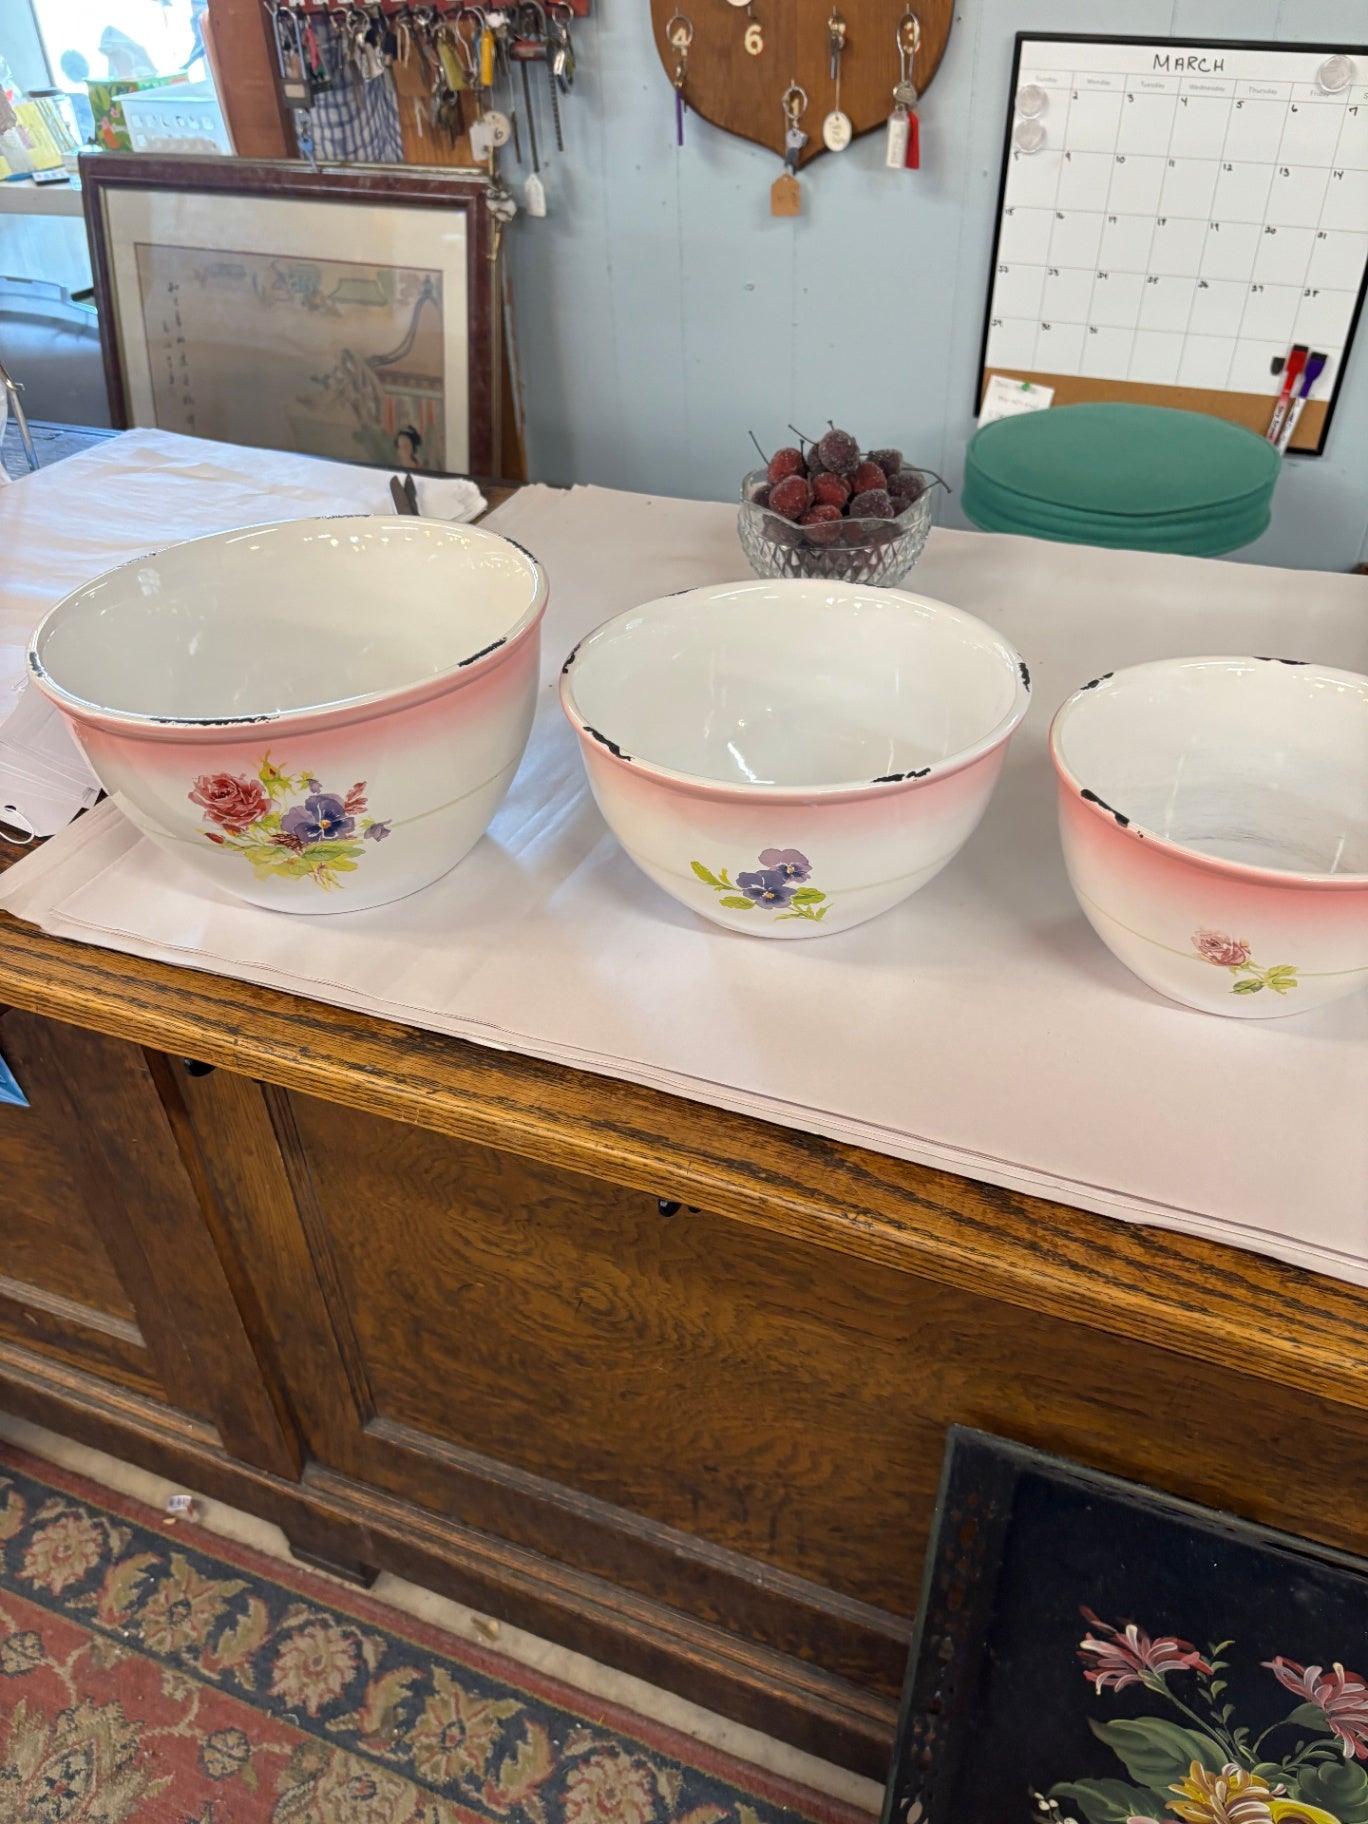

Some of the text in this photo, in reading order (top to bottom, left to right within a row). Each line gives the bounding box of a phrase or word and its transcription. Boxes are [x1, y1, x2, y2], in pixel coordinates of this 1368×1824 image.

[672, 27, 688, 56] 4
[744, 25, 763, 55] 6
[1153, 53, 1225, 73] MARCH
[1249, 86, 1277, 96] Thursday
[1073, 91, 1358, 116] 2 3 4 5 6 7
[494, 127, 503, 140] 6
[1065, 152, 1071, 161] 9
[1116, 155, 1125, 164] 10
[1169, 160, 1175, 168] 11
[1224, 163, 1233, 172] 12
[1280, 168, 1290, 178] 13
[1334, 171, 1344, 181] 14
[1210, 223, 1219, 232] 19
[1265, 226, 1276, 235] 20
[1317, 231, 1327, 240] 21
[1097, 272, 1108, 280] 24
[1252, 285, 1264, 293] 27
